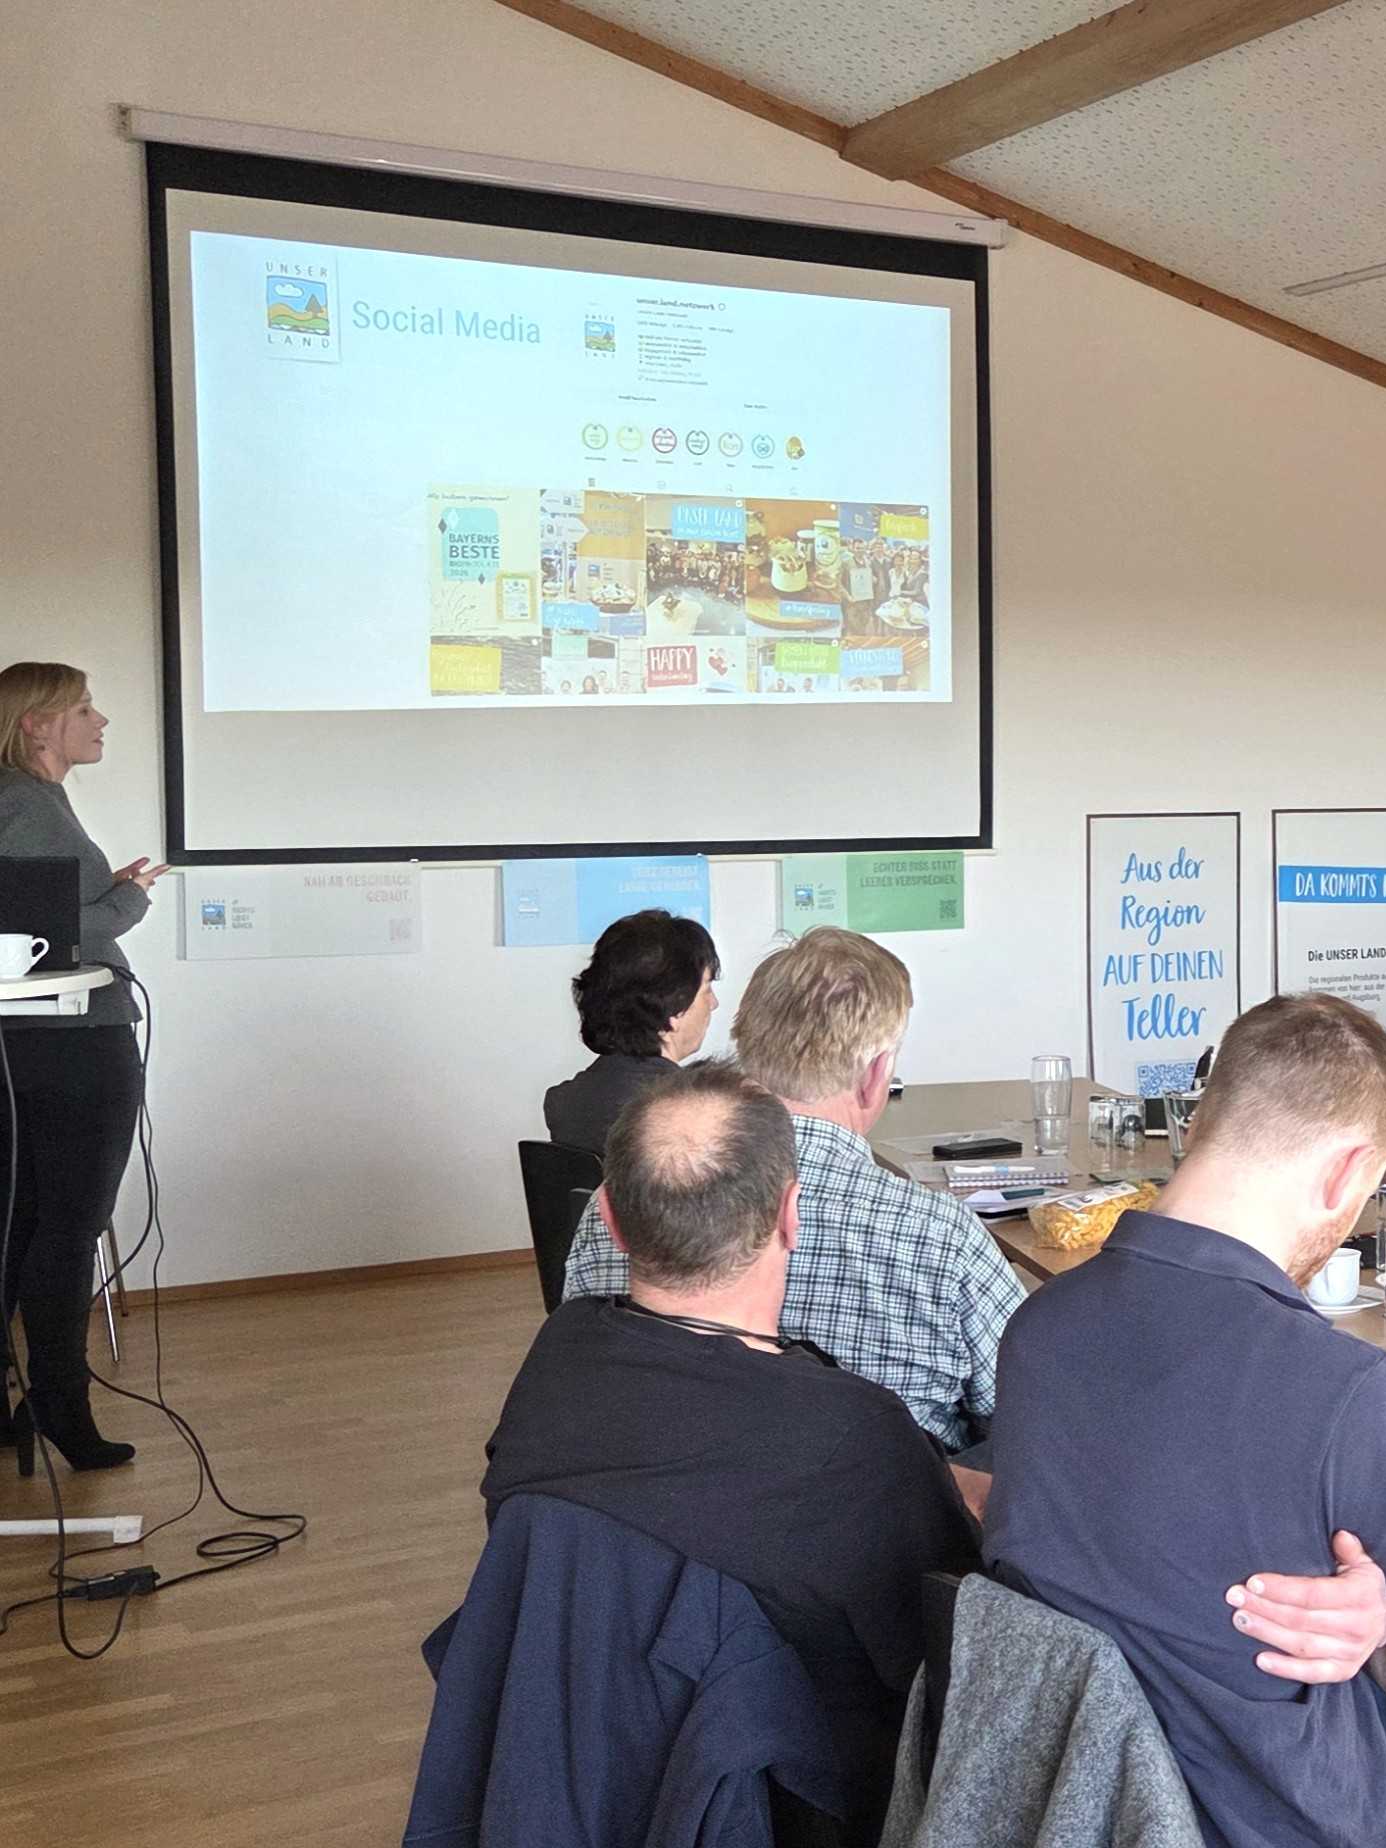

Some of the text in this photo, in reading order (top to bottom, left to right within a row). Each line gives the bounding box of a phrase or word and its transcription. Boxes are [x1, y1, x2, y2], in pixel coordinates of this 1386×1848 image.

[266, 262, 328, 277] UNSER
[352, 300, 541, 344] Social Media
[267, 333, 330, 349] LAND
[449, 533, 500, 545] BAYERNS
[449, 545, 500, 560] BESTE
[650, 648, 694, 671] HAPPY
[931, 860, 958, 871] STATT
[1120, 847, 1205, 885] Aus der
[1295, 872, 1316, 897] DA
[1121, 895, 1205, 946] Region
[1308, 950, 1324, 962] Die
[1326, 949, 1359, 961] UNSER
[1361, 947, 1386, 959] LAND
[1103, 950, 1224, 987] AUF DEINEN
[1122, 993, 1207, 1042] Teller
